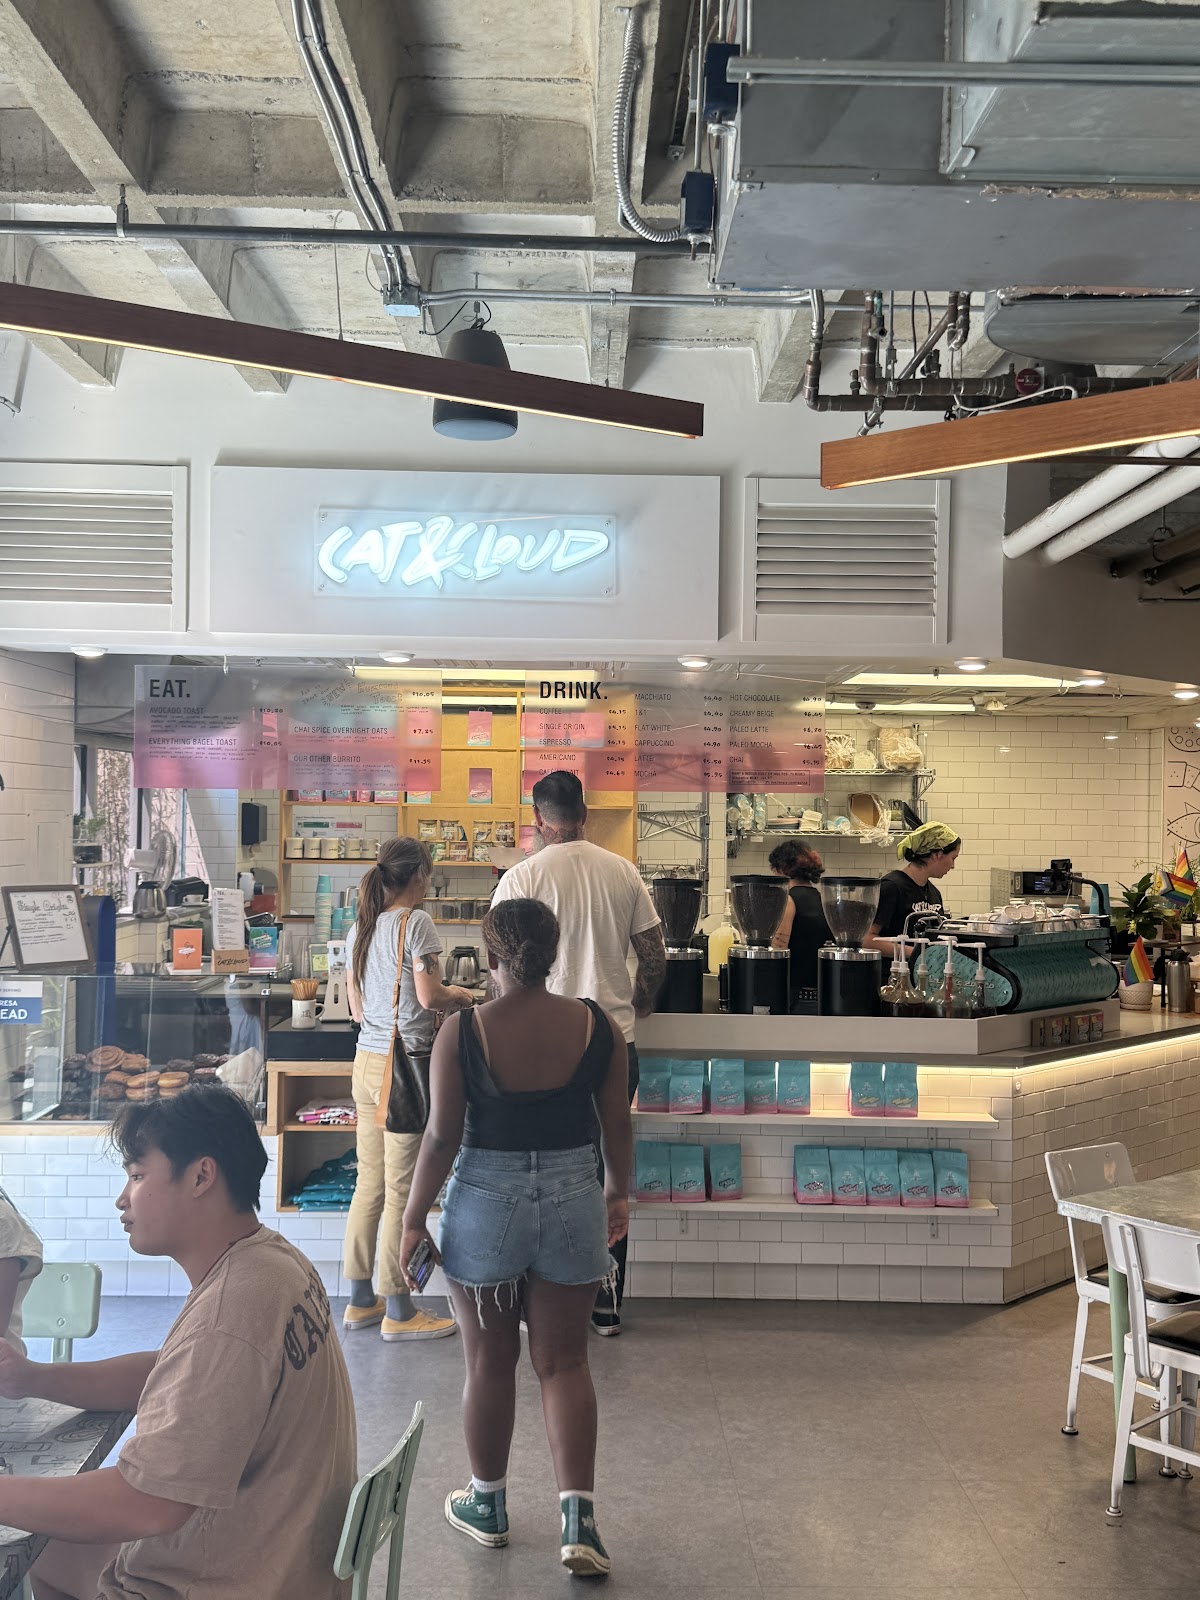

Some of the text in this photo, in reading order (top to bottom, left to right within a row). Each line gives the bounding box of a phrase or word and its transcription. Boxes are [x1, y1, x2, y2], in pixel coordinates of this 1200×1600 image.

[149, 679, 191, 698] EAT.
[539, 681, 608, 700] DRINK.
[634, 693, 672, 701] MACCHIATO
[729, 694, 781, 702] HOT CHOCOLATE
[149, 707, 205, 715] AVOCADO TOAST
[539, 707, 562, 715] COFFEE
[756, 710, 775, 718] BEIGE
[294, 726, 388, 735] CHAI SPICE OVERNIGHT OATS
[563, 723, 586, 731] ORIGIN
[729, 725, 749, 733] PALEO
[148, 738, 237, 746] EVERYTHING BAGEL TOAST
[539, 738, 572, 746] ESPRESSO
[634, 739, 675, 747] CAPPUCCINO
[293, 755, 308, 763] OUR
[309, 755, 331, 763] OTHER
[0, 1008, 28, 1020] EAD
